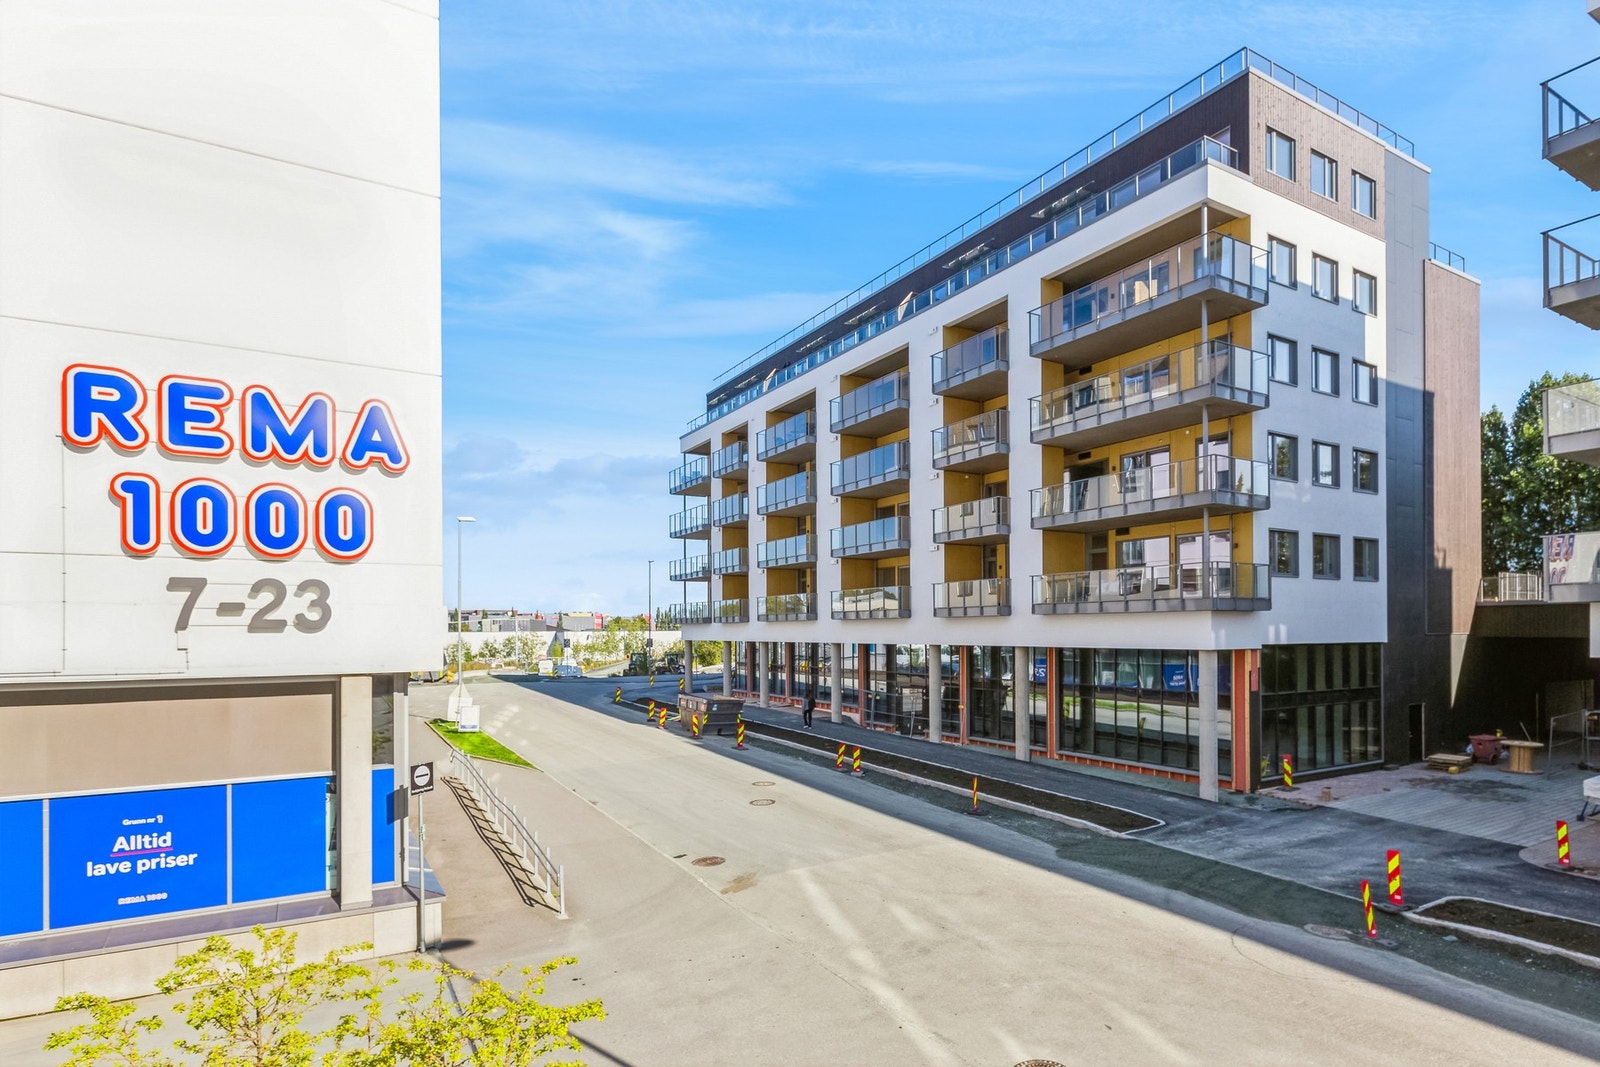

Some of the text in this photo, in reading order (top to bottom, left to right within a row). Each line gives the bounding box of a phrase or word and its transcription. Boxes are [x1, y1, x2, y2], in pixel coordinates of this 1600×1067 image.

[62, 363, 410, 472] REMA
[110, 472, 374, 561] 1000
[166, 577, 332, 634] 7-23
[156, 814, 163, 824] 1
[112, 831, 172, 852] Alltid
[86, 853, 198, 877] lave priser
